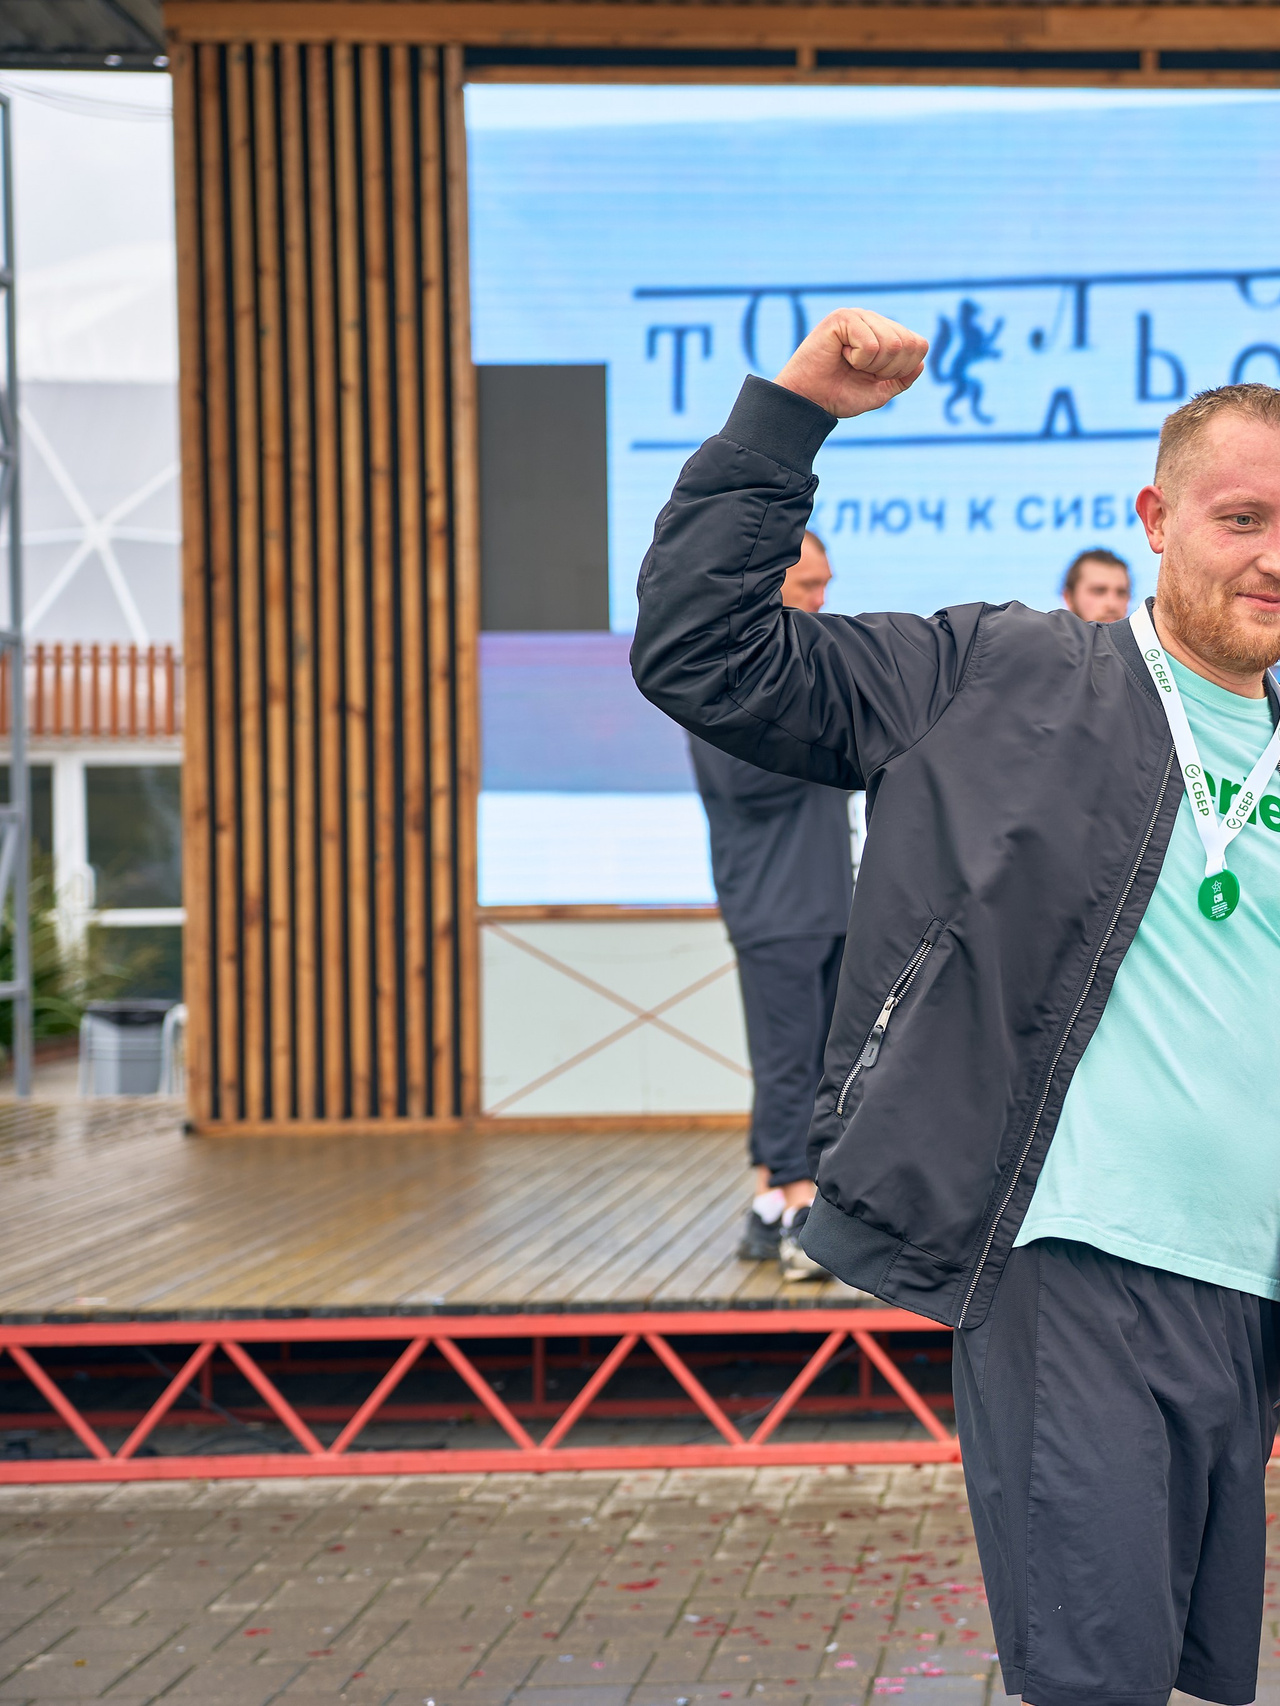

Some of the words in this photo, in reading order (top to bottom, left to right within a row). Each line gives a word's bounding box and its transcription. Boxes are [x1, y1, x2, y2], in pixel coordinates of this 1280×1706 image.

[967, 497, 996, 531] К
[1152, 663, 1172, 693] СБЕР
[1192, 781, 1210, 816] СБЕР
[1235, 791, 1255, 817] СБЕР
